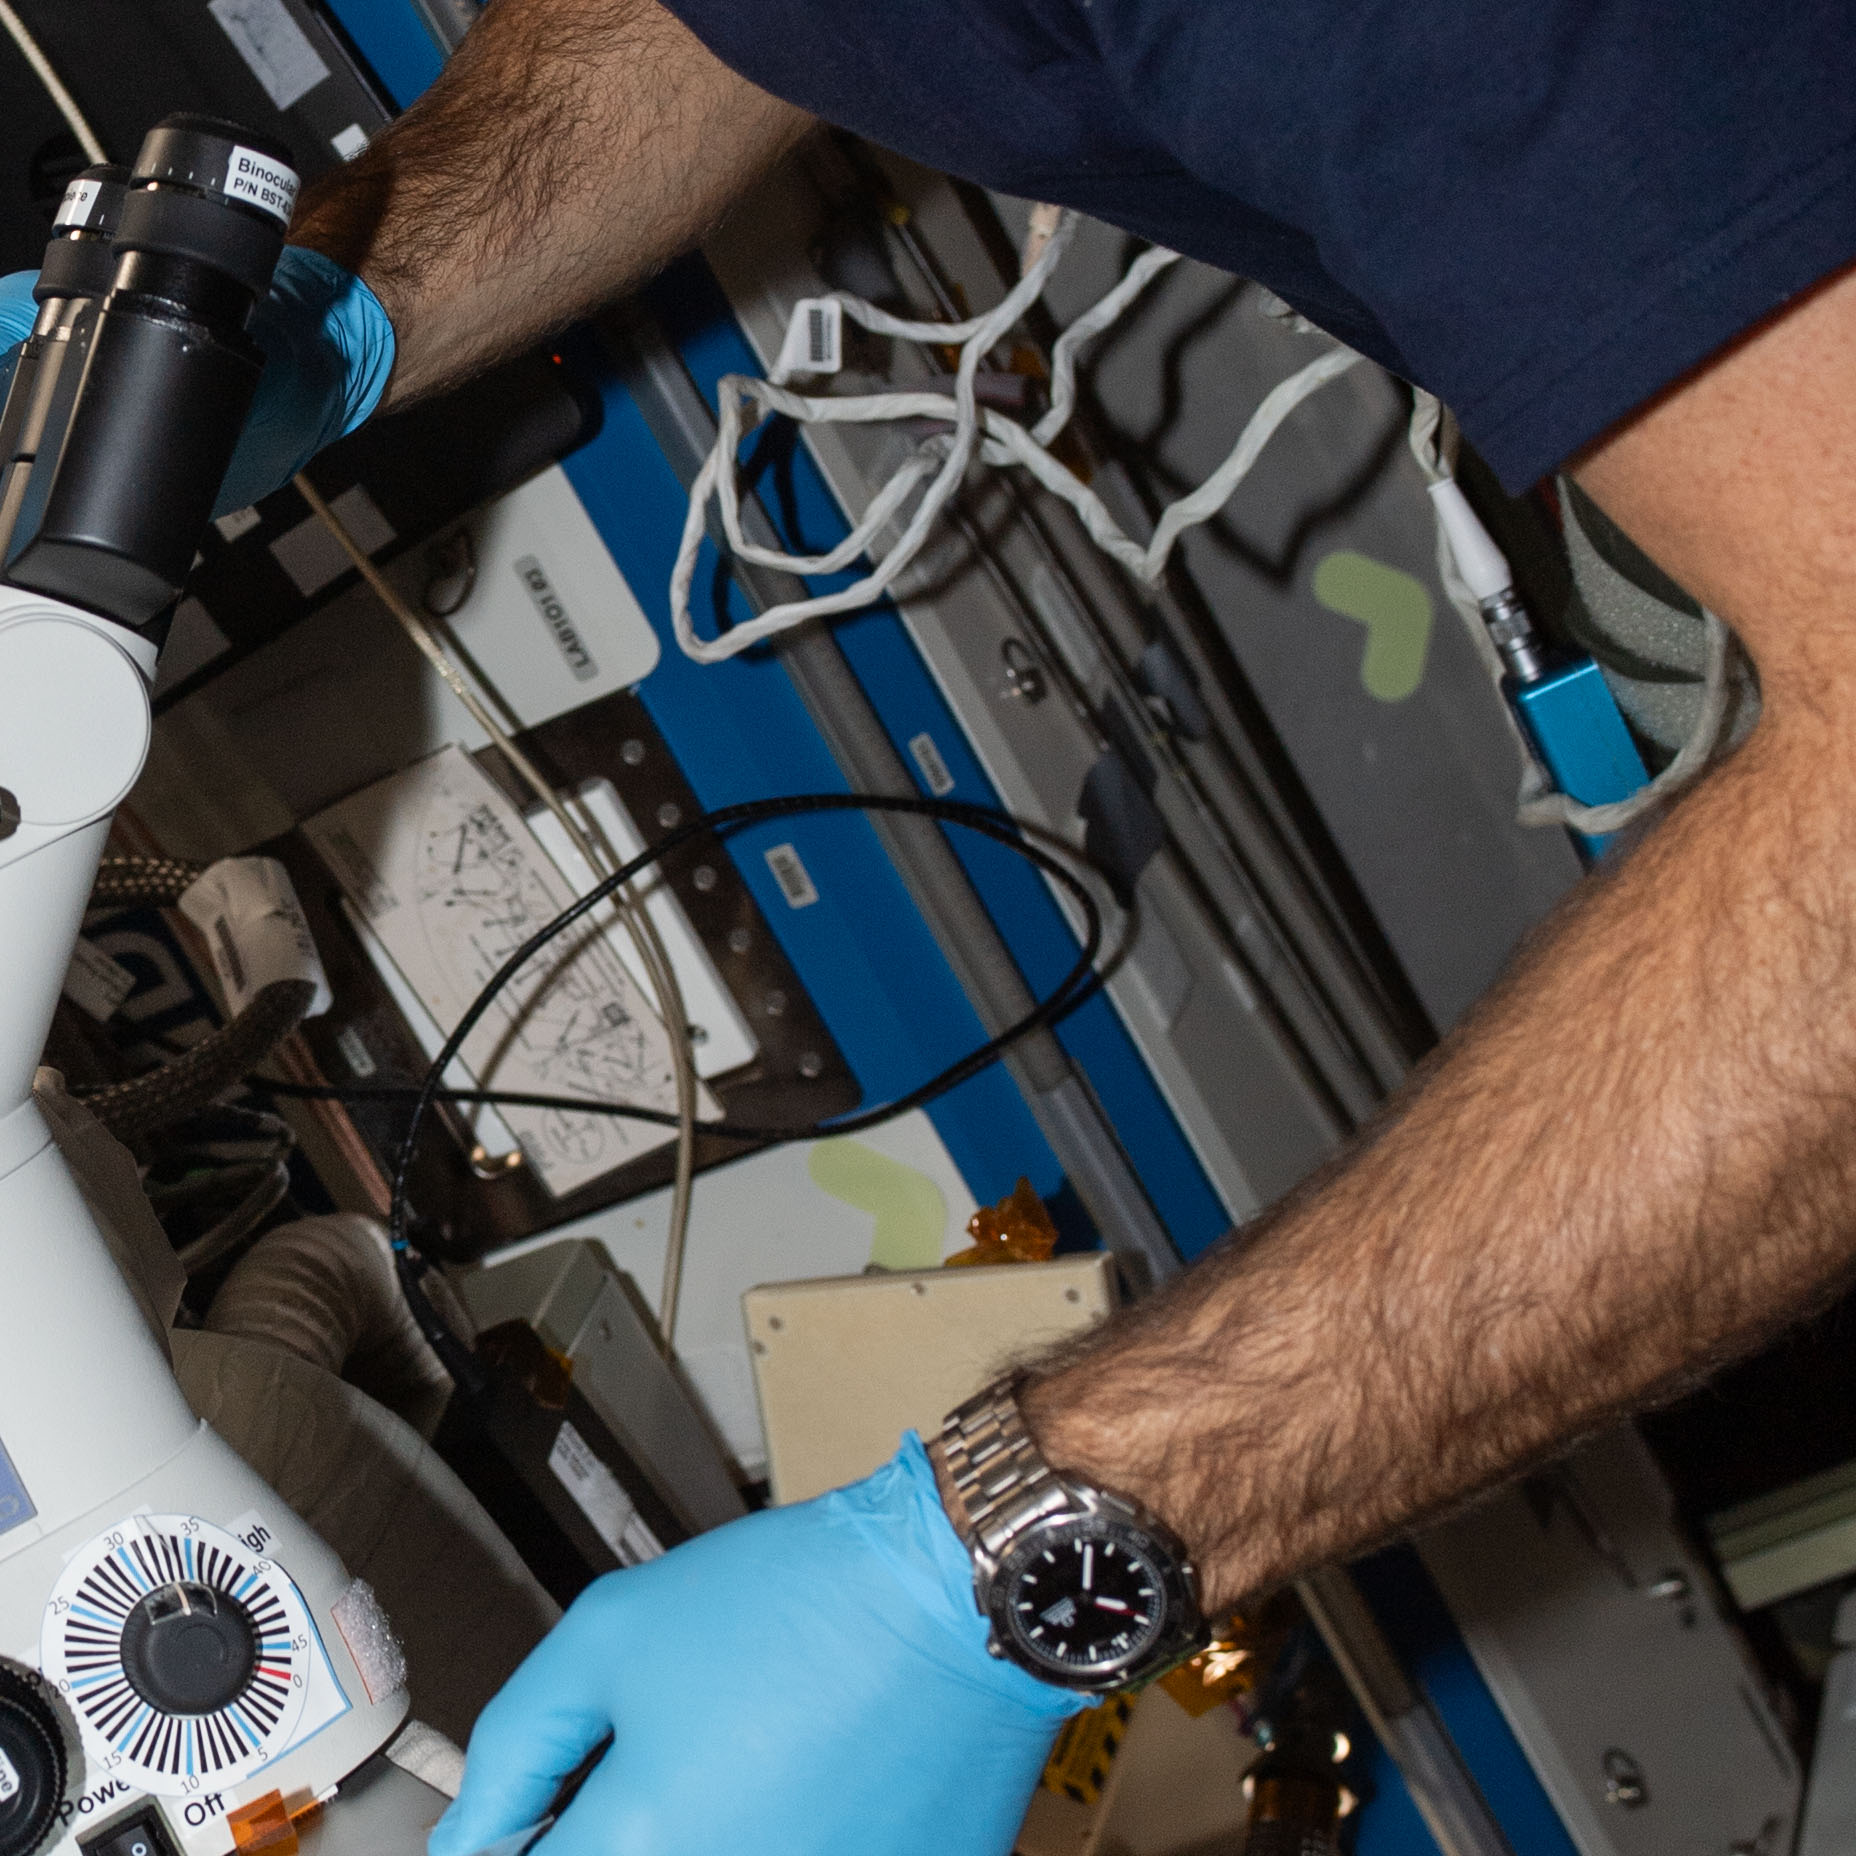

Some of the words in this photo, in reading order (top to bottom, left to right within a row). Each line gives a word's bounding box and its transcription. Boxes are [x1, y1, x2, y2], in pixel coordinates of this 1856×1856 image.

[232, 178, 257, 199] P/N
[181, 1519, 199, 1536] 35
[105, 1532, 124, 1550] 30
[253, 1560, 272, 1576] 40
[49, 1596, 69, 1615] 25
[291, 1635, 307, 1651] 45
[294, 1677, 303, 1688] 0
[104, 1750, 122, 1767] 15
[259, 1746, 268, 1761] 5
[181, 1776, 200, 1793] 10
[55, 1775, 129, 1826] Powe
[184, 1794, 224, 1826] Off
